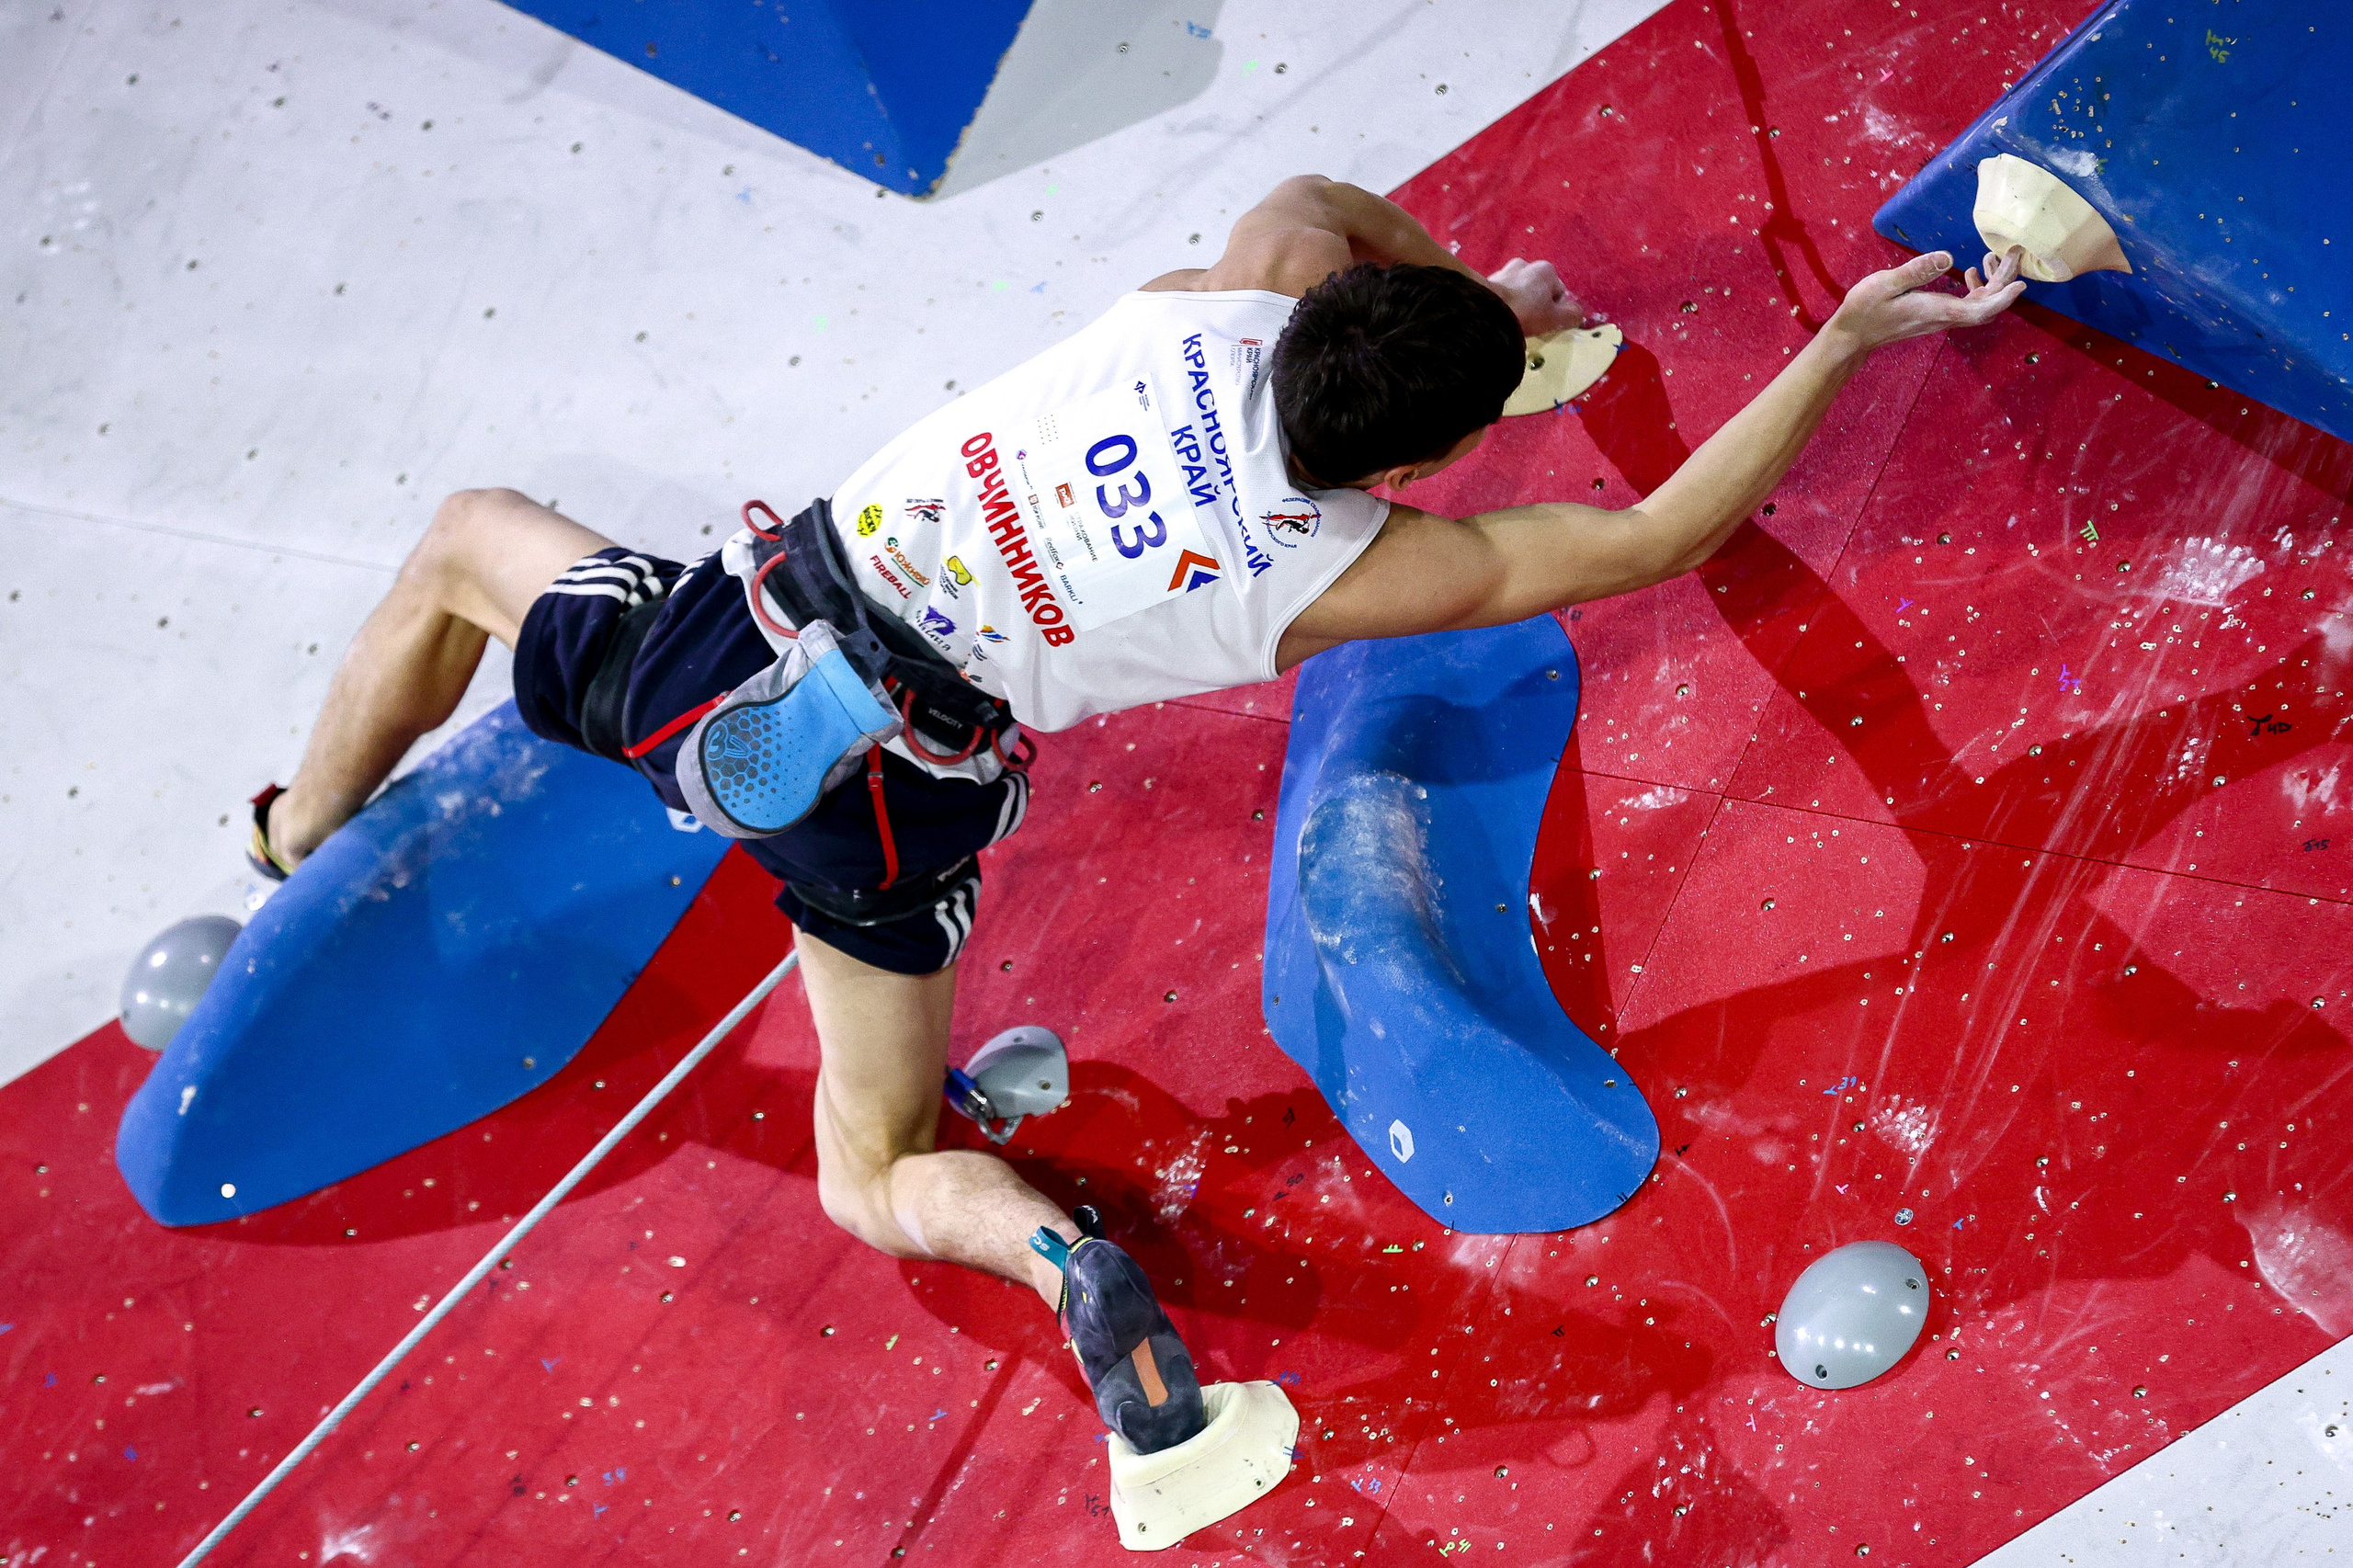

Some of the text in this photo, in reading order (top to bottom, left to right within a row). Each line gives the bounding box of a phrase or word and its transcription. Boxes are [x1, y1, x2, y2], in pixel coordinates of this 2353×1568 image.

[1248, 347, 1261, 401] КРАСНОЯРСК
[1171, 425, 1221, 507] КРАЙ
[1085, 434, 1167, 559] 033
[961, 432, 1075, 647] ОВЧИННИКОВ
[1074, 512, 1097, 562] СТРАХОВАНИЕ
[870, 554, 913, 600] FIREBALL
[1060, 574, 1077, 601] BARKLI
[928, 707, 962, 728] VELOCITY
